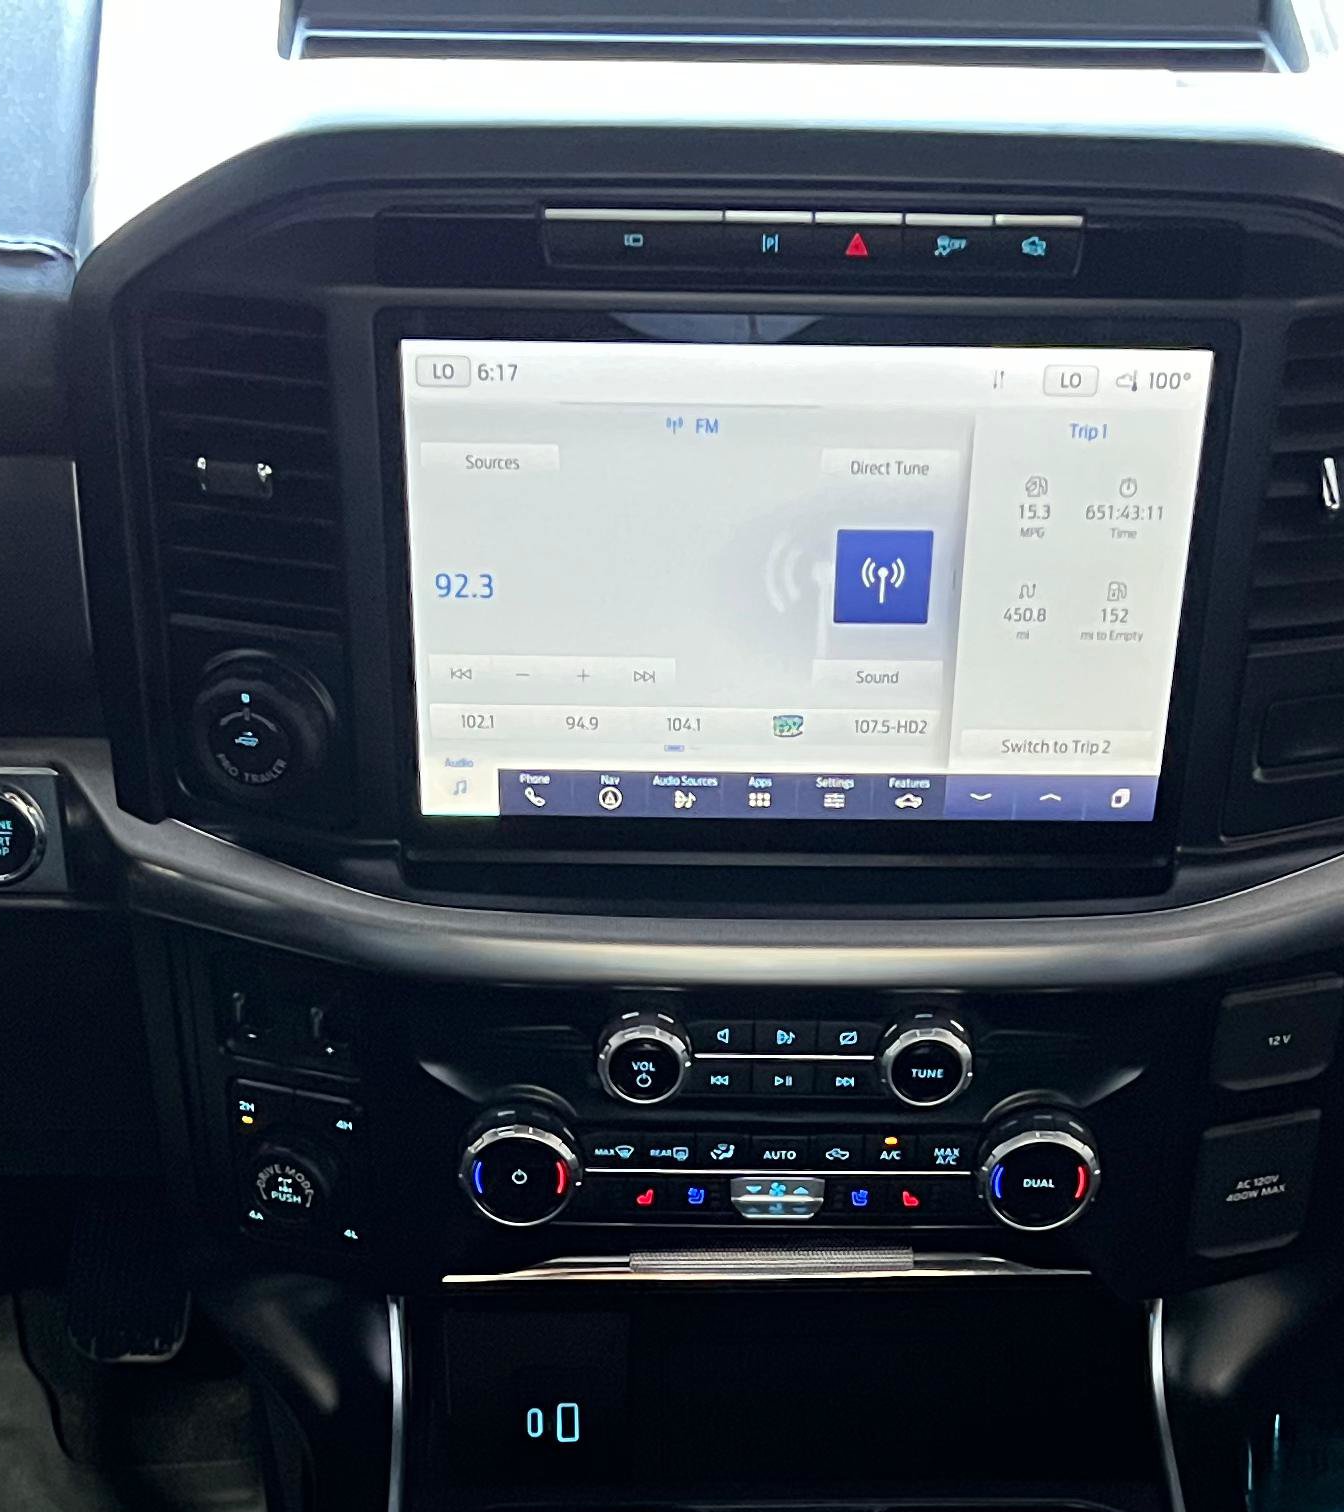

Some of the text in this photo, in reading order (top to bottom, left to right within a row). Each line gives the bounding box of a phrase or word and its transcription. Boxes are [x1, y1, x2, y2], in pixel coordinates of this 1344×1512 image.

[432, 363, 518, 382] LO 6:17
[1060, 371, 1192, 390] LO 100°
[695, 418, 719, 434] FM
[1069, 422, 1108, 442] Trip 1
[465, 454, 520, 471] Sources
[850, 460, 930, 477] Direct Tune
[1019, 504, 1051, 520] 15.3
[1085, 504, 1164, 521] 651:43:11
[1020, 527, 1045, 539] MPG
[1109, 527, 1138, 540] Time
[435, 573, 494, 599] 92.3
[1003, 607, 1047, 624] 450.8
[1100, 607, 1129, 624] 152
[1016, 630, 1030, 641] mi
[1080, 630, 1144, 643] mi to Empty
[856, 670, 899, 685] Sound
[460, 713, 495, 730] 102.1
[566, 715, 599, 731] 94.9
[666, 716, 701, 733] 104.1
[854, 719, 928, 735] 107.5-HD2
[1001, 738, 1111, 757] Switch to Trip 2
[444, 756, 474, 769] Audio
[519, 773, 551, 786] Phone
[600, 774, 620, 786] Nav
[652, 774, 718, 787] Audio Sources
[748, 776, 773, 790] Apps
[816, 776, 855, 790] Settings
[889, 776, 931, 790] Features
[1267, 1033, 1292, 1047] 12 V
[632, 1060, 656, 1073] VOL
[911, 1067, 944, 1079] TUNE
[239, 1100, 255, 1113] 2H
[594, 1148, 615, 1156] MAX
[650, 1148, 672, 1157] REAR
[763, 1150, 797, 1161] AUTO
[880, 1149, 902, 1162] A/C
[933, 1147, 960, 1158] MAX
[936, 1155, 957, 1165] A/C
[256, 1163, 315, 1196] DRIVE MODE
[1023, 1178, 1056, 1189] DUAL
[1235, 1174, 1280, 1190] AC 120V
[271, 1190, 302, 1205] PUSH
[1225, 1183, 1287, 1203] 400W MAX
